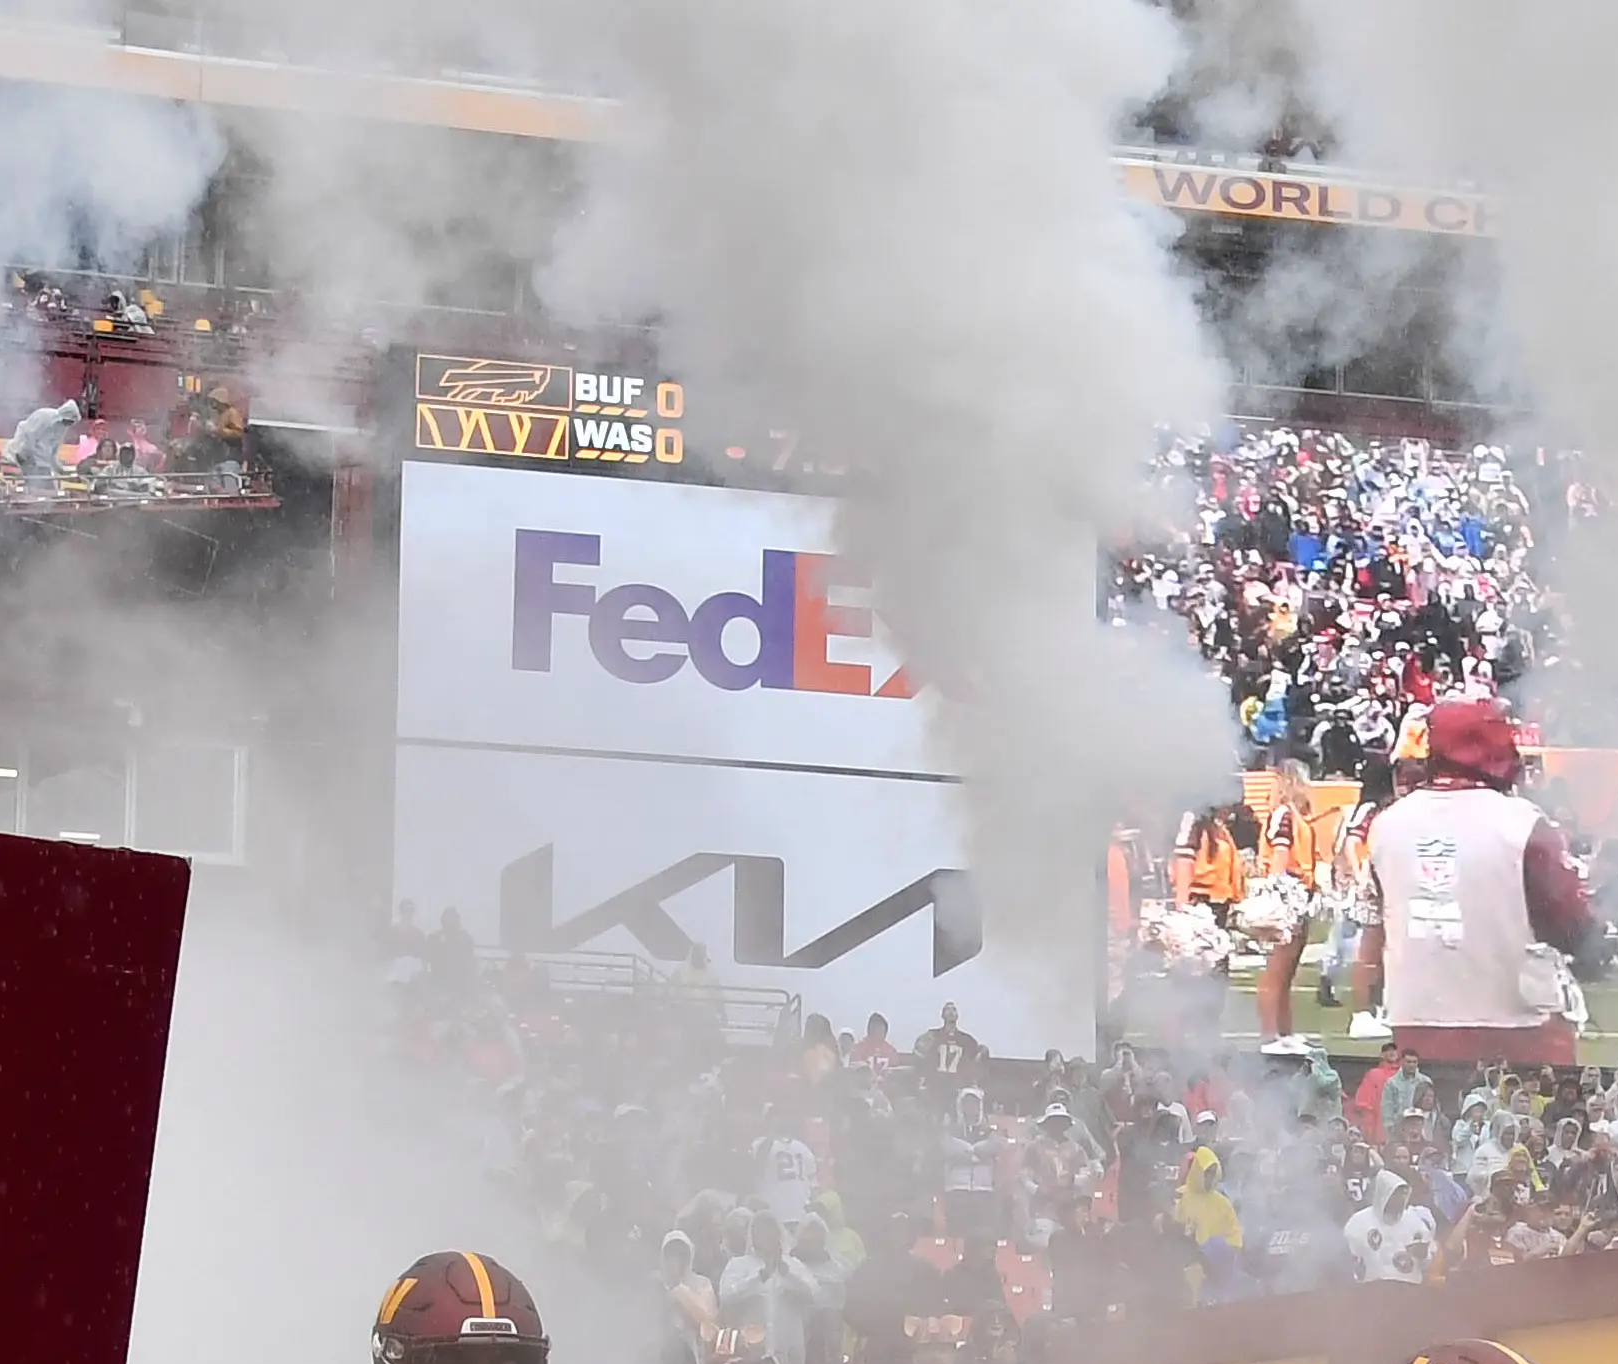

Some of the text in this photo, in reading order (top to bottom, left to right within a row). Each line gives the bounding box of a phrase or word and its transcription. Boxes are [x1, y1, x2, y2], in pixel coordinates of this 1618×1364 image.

[1152, 167, 1402, 223] WORLD
[574, 372, 685, 419] BUF 0
[572, 417, 684, 464] WAS 0
[936, 1043, 964, 1074] 17
